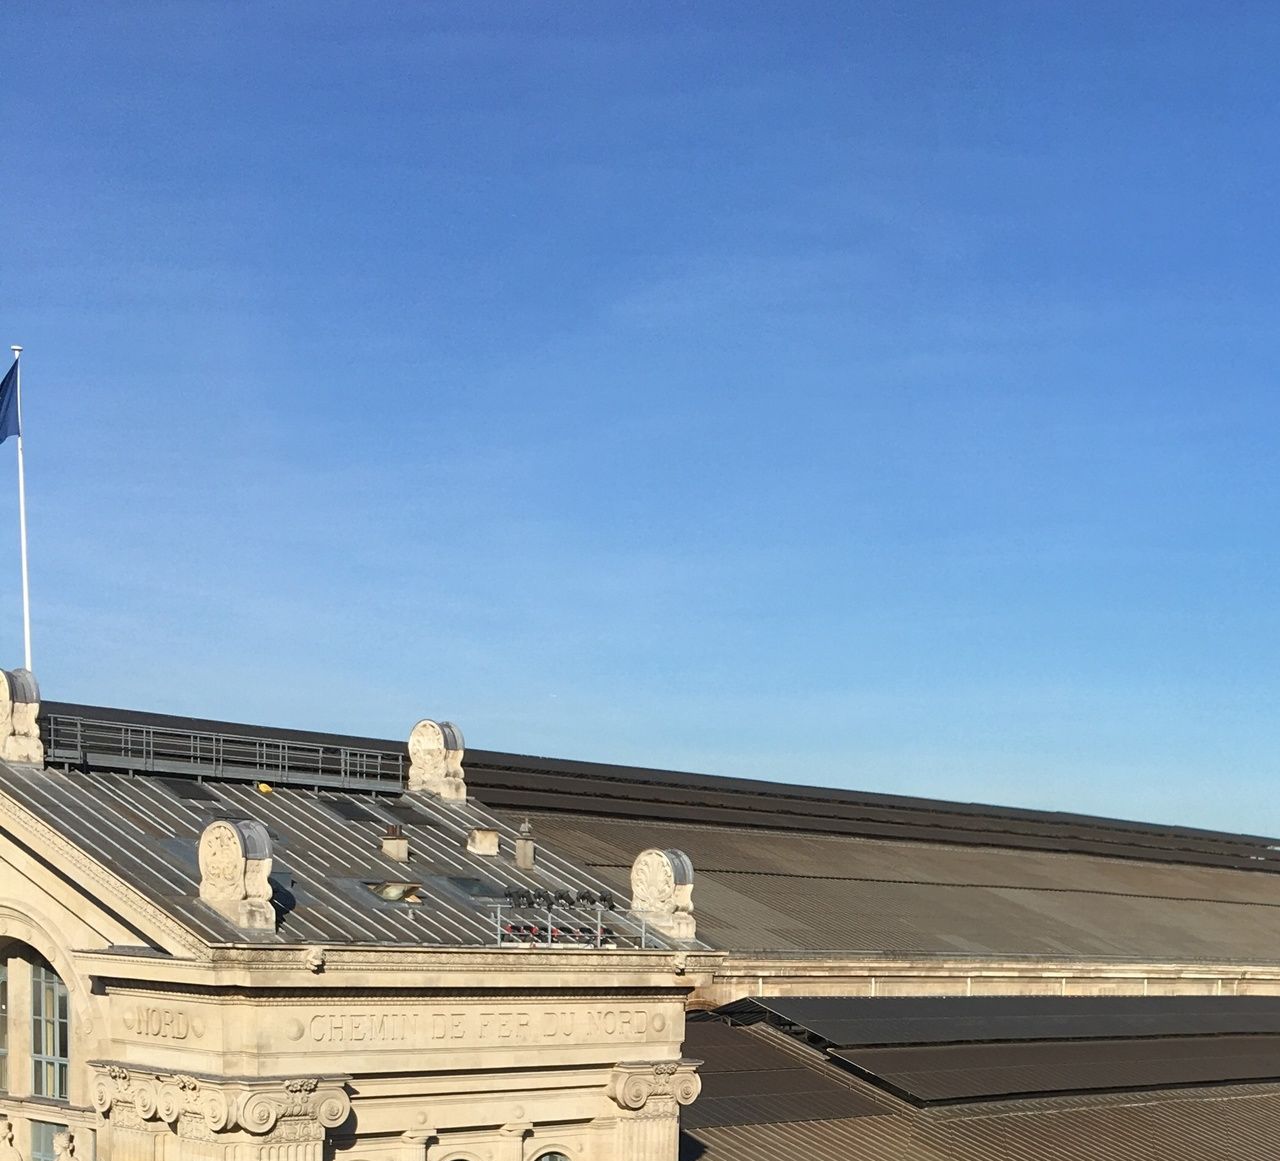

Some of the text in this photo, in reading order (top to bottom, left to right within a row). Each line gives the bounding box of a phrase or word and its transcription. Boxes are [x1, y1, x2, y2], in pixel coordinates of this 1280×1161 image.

[132, 1006, 190, 1040] NORD
[309, 1010, 648, 1042] CHEMIN DE FER DU NORD
